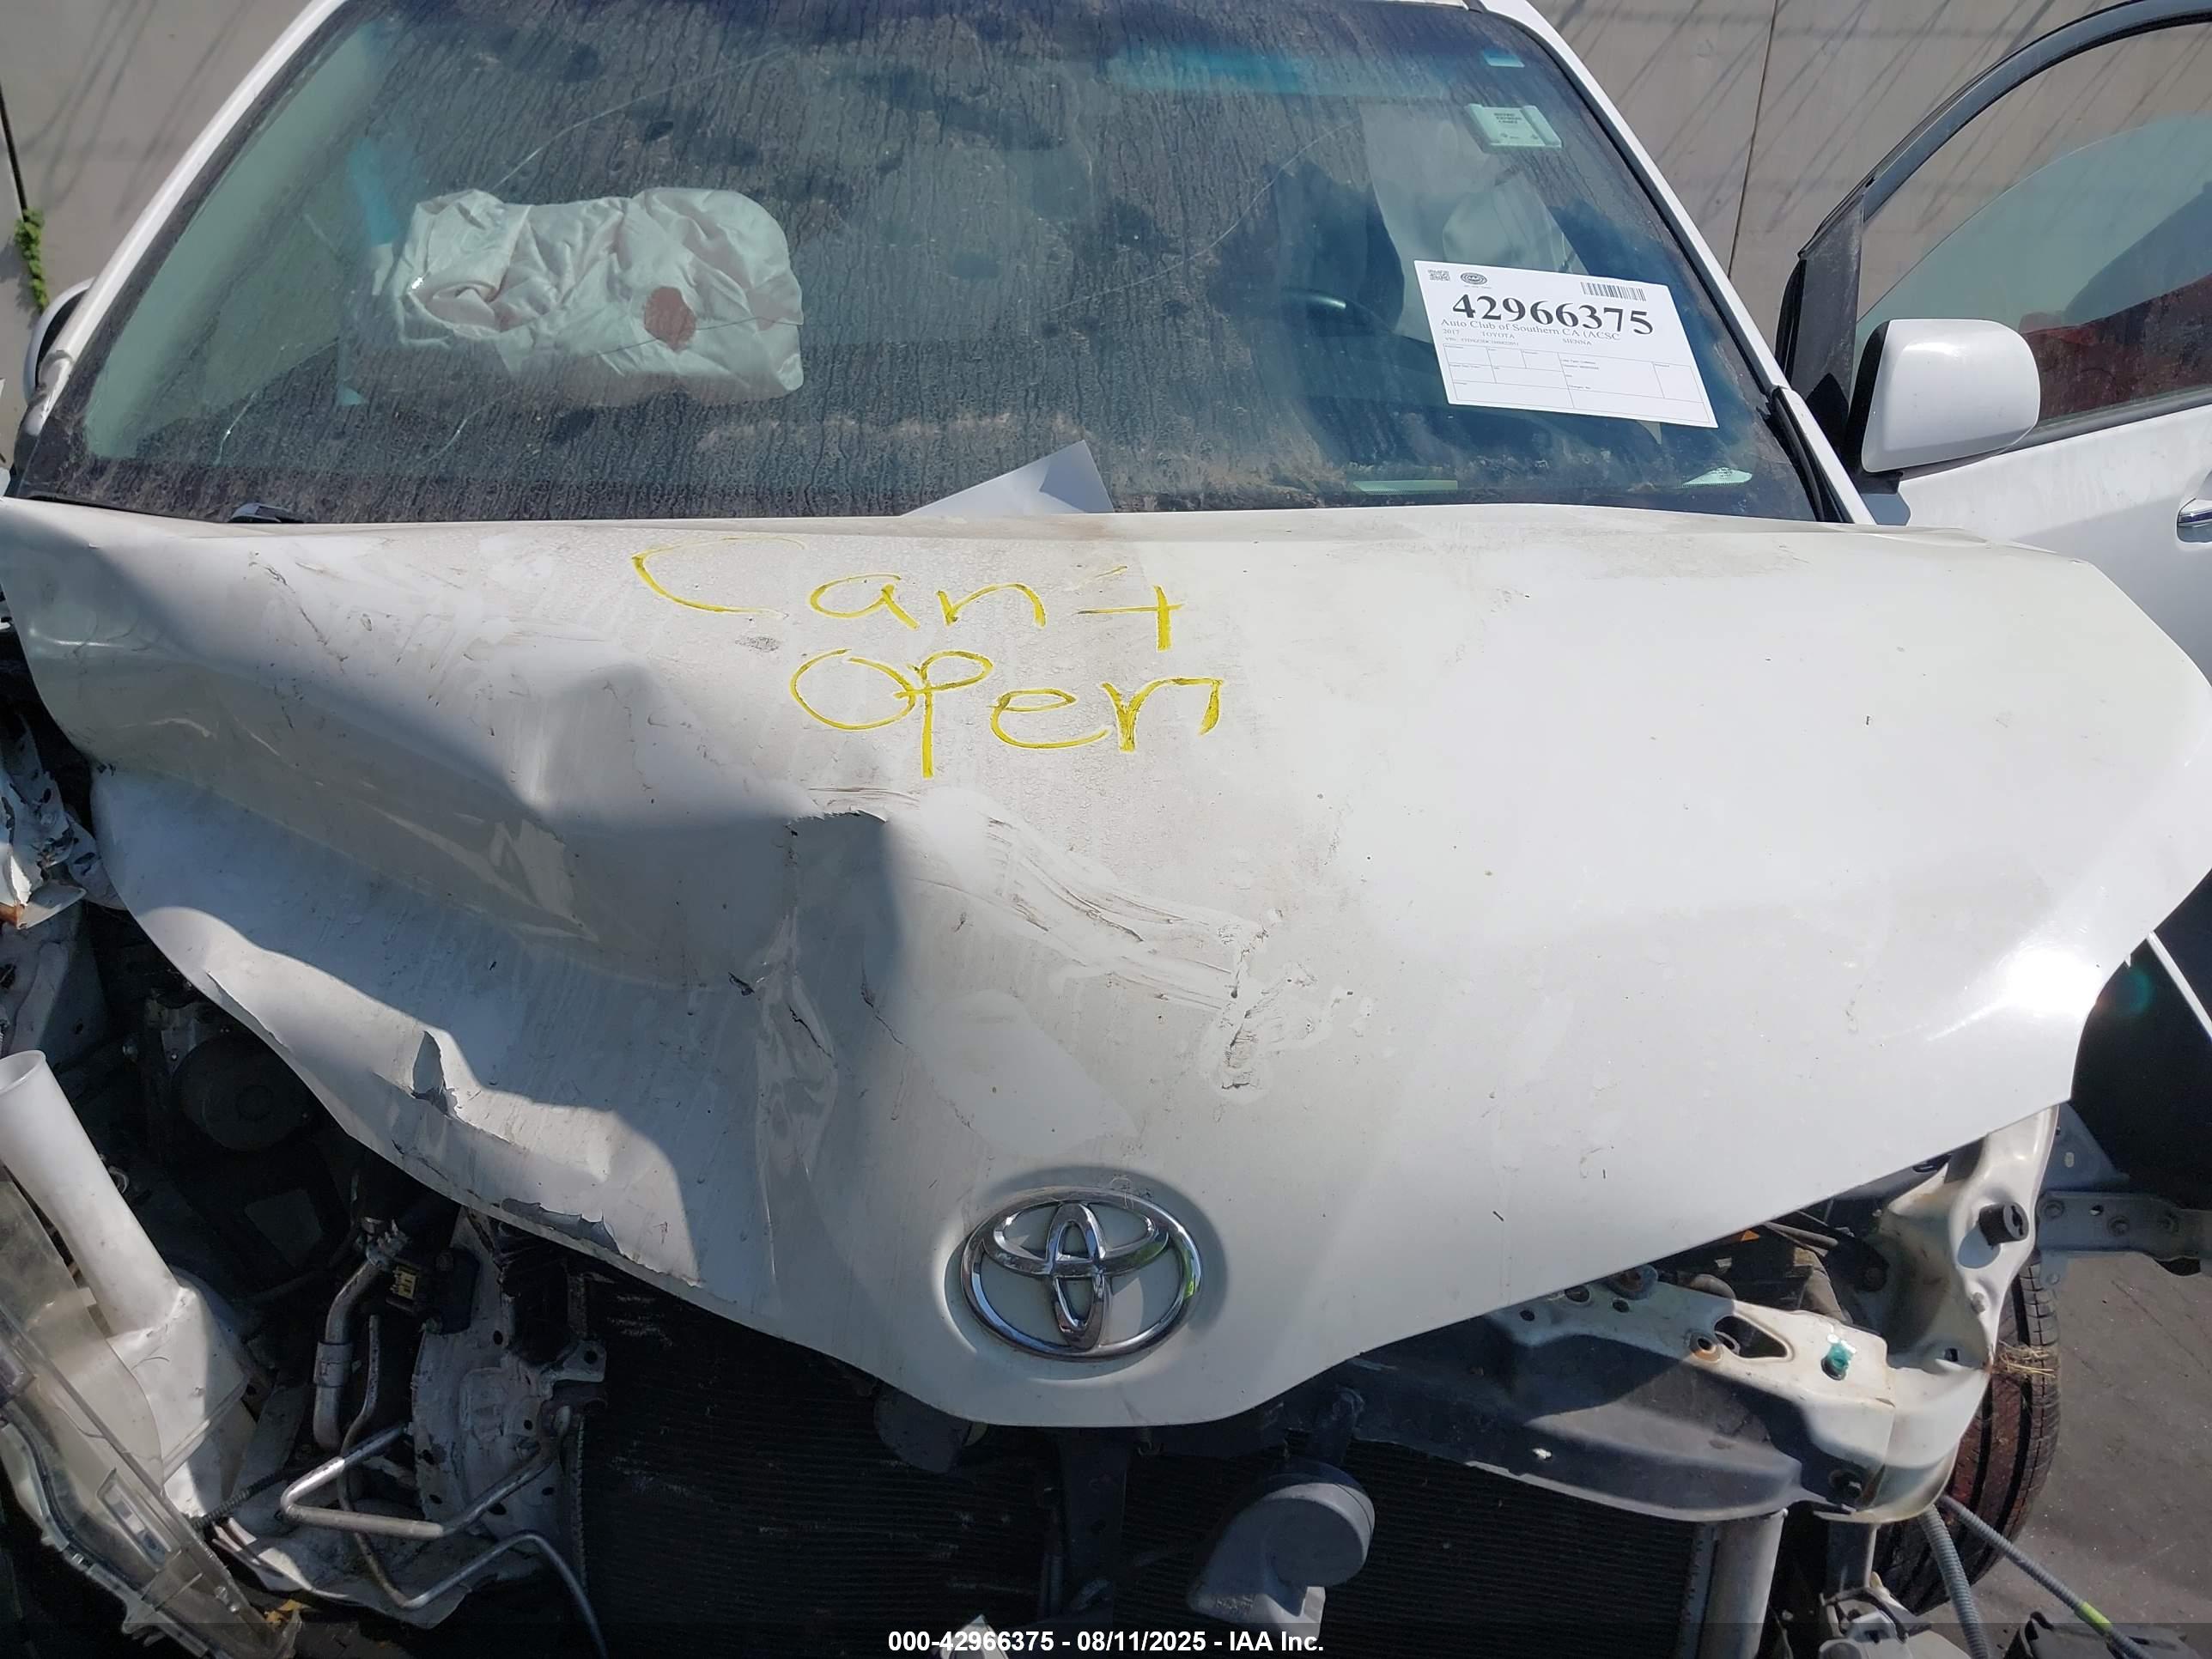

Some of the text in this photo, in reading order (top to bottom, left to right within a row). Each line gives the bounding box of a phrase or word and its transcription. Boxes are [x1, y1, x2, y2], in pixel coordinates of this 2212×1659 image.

[1453, 294, 1654, 335] 42966375
[1442, 319, 1468, 327] Auto
[1469, 321, 1496, 330] Club
[1512, 324, 1560, 335] Southern
[1562, 328, 1580, 337] CA
[1481, 331, 1516, 339] TOYOTA
[1562, 337, 1593, 346] SIENNA
